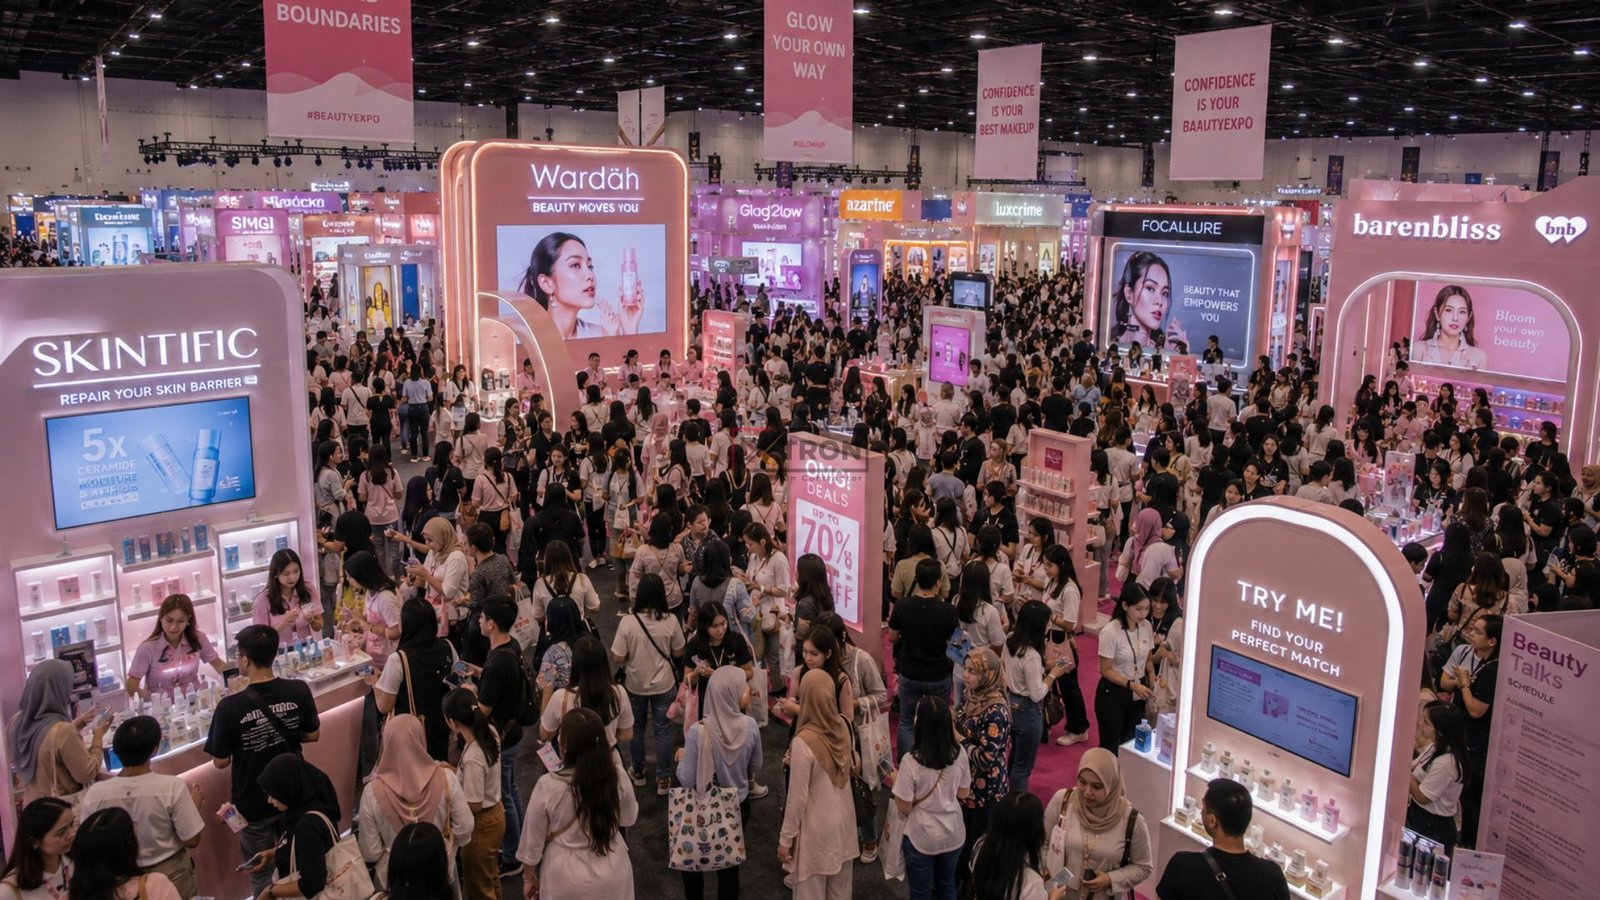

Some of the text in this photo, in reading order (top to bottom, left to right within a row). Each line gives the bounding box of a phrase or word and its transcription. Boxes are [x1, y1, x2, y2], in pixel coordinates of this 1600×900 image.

[277, 3, 401, 34] BOUNDARIES
[787, 11, 833, 33] GLOW
[773, 35, 846, 58] YOUR OWN
[793, 62, 826, 80] WAY
[1184, 72, 1256, 92] CONFIDENCE
[982, 85, 1035, 99] CONFIDENCE
[992, 104, 1023, 117] IS YOUR
[1197, 96, 1240, 112] IS YOUR
[307, 111, 380, 123] #BEAUTYEXPO
[1183, 116, 1253, 133] BAAUTYEXPO
[980, 122, 1035, 135] BEST MAKEUP
[533, 202, 639, 213] BEAUTY MOVES YOU
[995, 200, 1043, 216] luxcrime
[1142, 219, 1222, 235] FOCALLURE
[1354, 213, 1502, 240] barenbliss
[1545, 221, 1577, 236] bnb
[1183, 285, 1240, 298] BEAUTY THAT
[1184, 297, 1239, 311] EMPOWERS
[1200, 311, 1220, 322] YOU
[1495, 309, 1536, 324] Bloom
[1493, 326, 1545, 337] your own
[33, 327, 259, 377] SKINTIFIC
[1494, 335, 1540, 354] beauty
[60, 377, 242, 405] REPAIR YOUR SKIN BARRIER
[82, 428, 128, 462] 5x
[78, 459, 137, 475] CERAMIDE
[805, 459, 851, 490] OMG!
[807, 482, 848, 508] DEALS
[1237, 580, 1344, 633] TRY ME!
[1251, 619, 1323, 654] FIND YOUR
[1231, 629, 1287, 657] PERFECT
[1291, 649, 1340, 677] MATCH
[1512, 631, 1588, 678] Beauty
[1511, 652, 1563, 690] Talks
[1507, 677, 1555, 704] SCHEDULE
